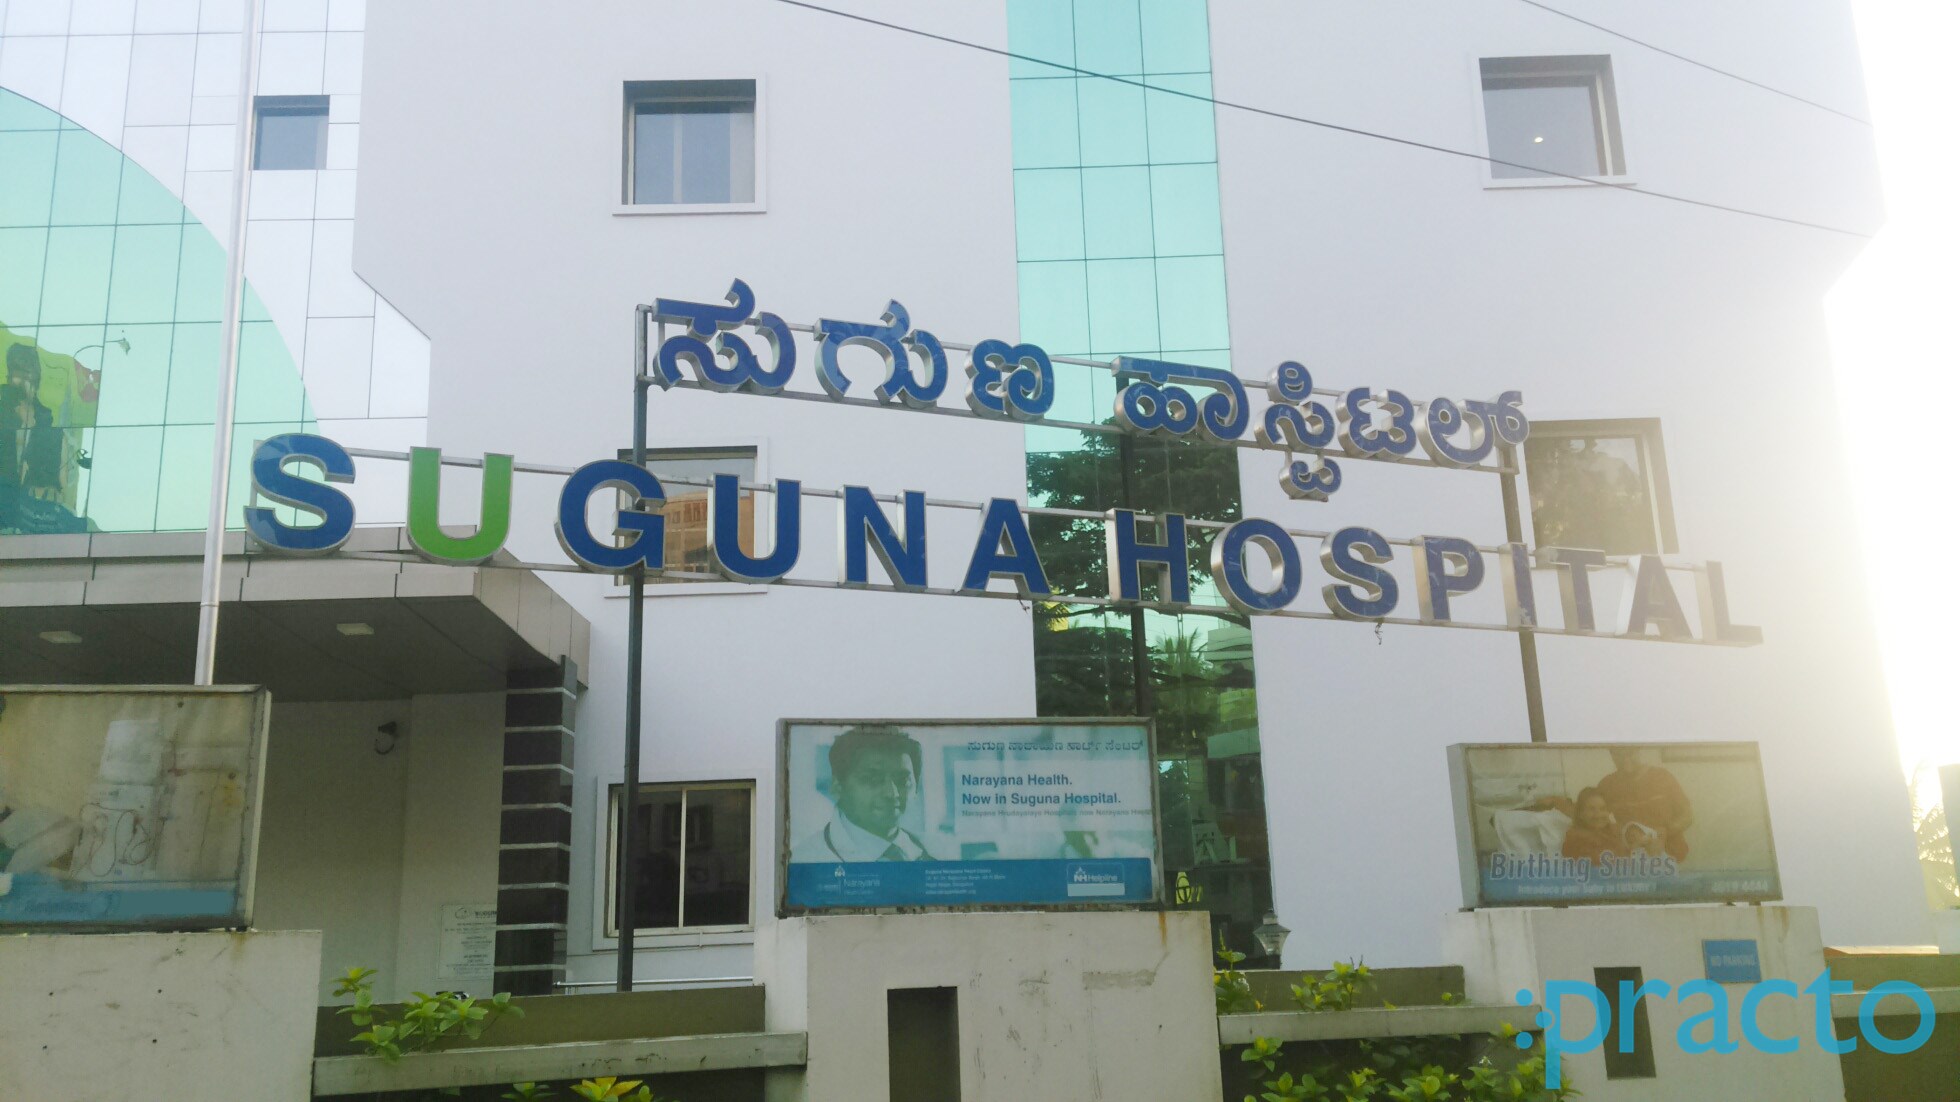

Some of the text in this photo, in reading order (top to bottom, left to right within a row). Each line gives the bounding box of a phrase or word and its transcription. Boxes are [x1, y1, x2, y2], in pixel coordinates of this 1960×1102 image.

[652, 278, 1054, 421] ಸುಗುಣ
[243, 433, 1764, 647] SUGUNA HOSPITAL
[961, 774, 1073, 788] Narayana Health.
[961, 792, 1121, 807] Now in Suguna Hospital.
[1489, 850, 1677, 885] Birthing Suites
